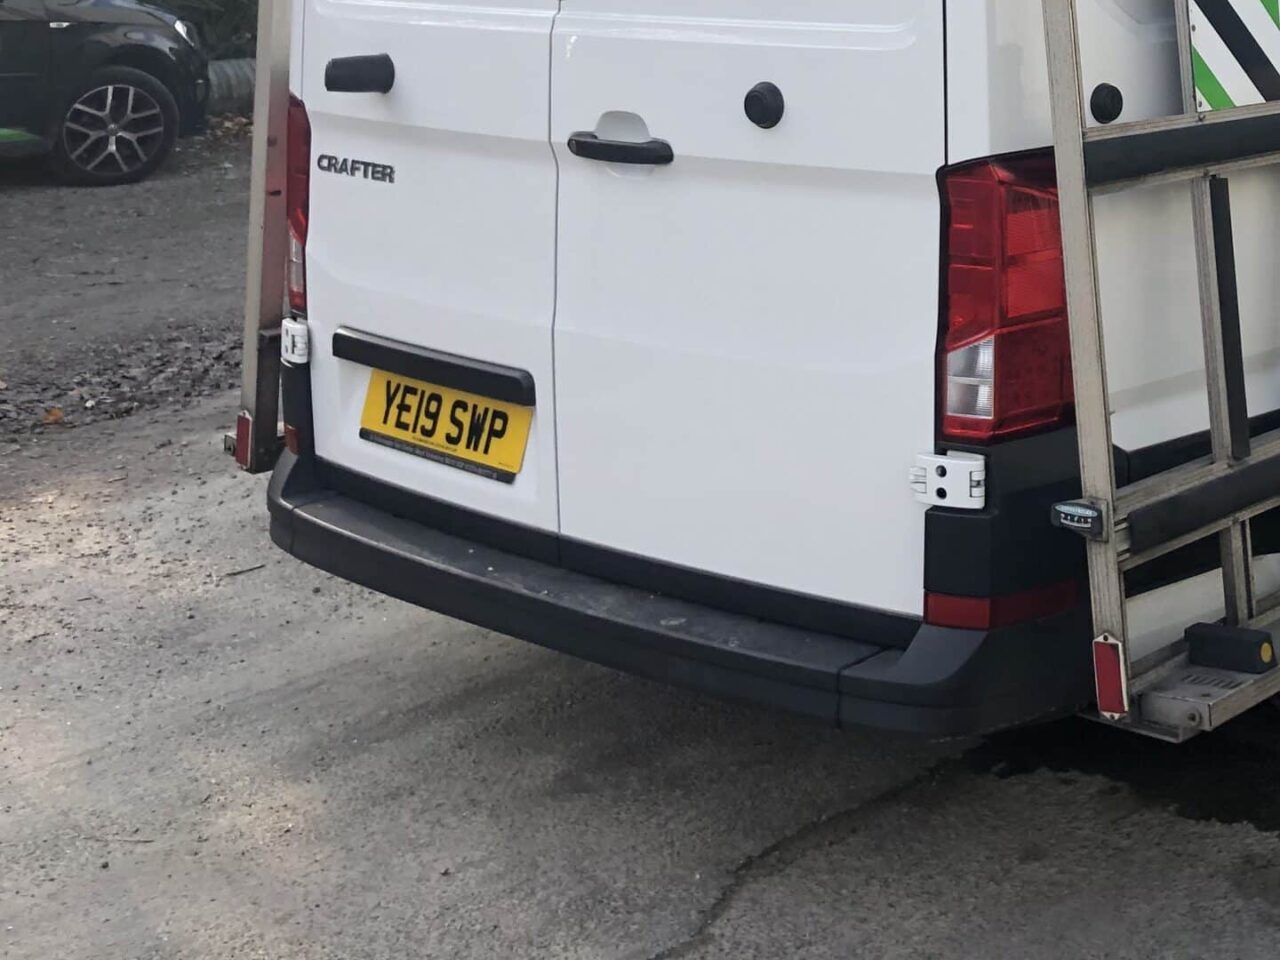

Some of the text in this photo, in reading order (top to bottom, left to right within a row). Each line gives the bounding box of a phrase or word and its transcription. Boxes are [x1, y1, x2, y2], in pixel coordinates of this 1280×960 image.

[317, 154, 395, 183] CRAFTER
[382, 380, 509, 455] YE19 SWP
